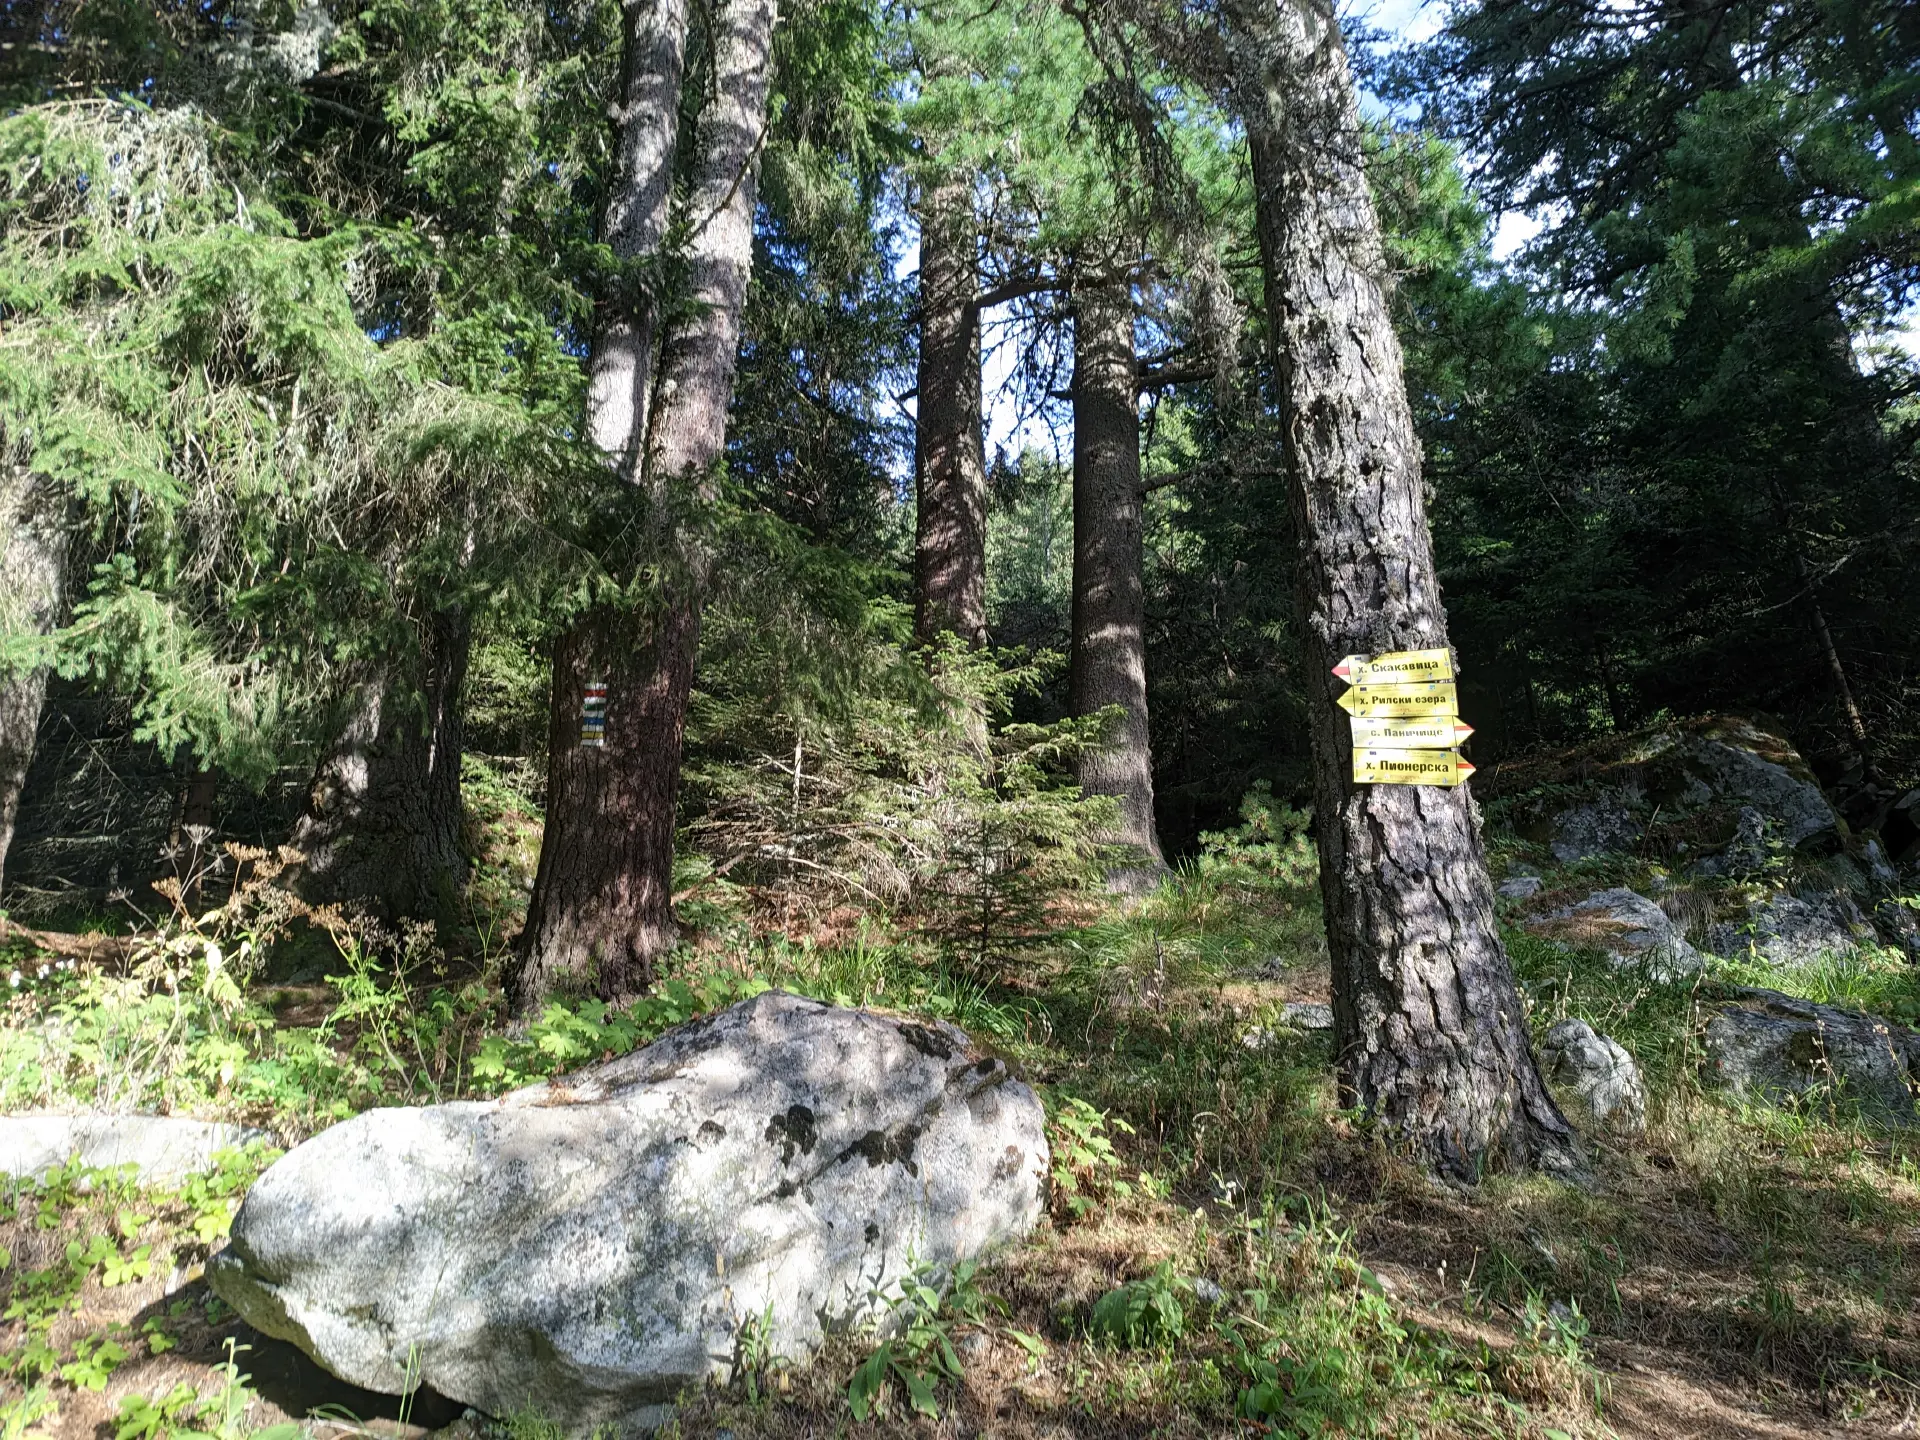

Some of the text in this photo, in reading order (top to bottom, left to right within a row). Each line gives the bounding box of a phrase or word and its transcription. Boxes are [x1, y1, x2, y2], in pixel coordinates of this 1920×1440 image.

[1371, 660, 1439, 673] Скакавица
[1372, 695, 1412, 705] Рилски
[1415, 695, 1446, 706] езера
[1384, 728, 1443, 738] Паничище
[1380, 760, 1449, 773] Пионерска
